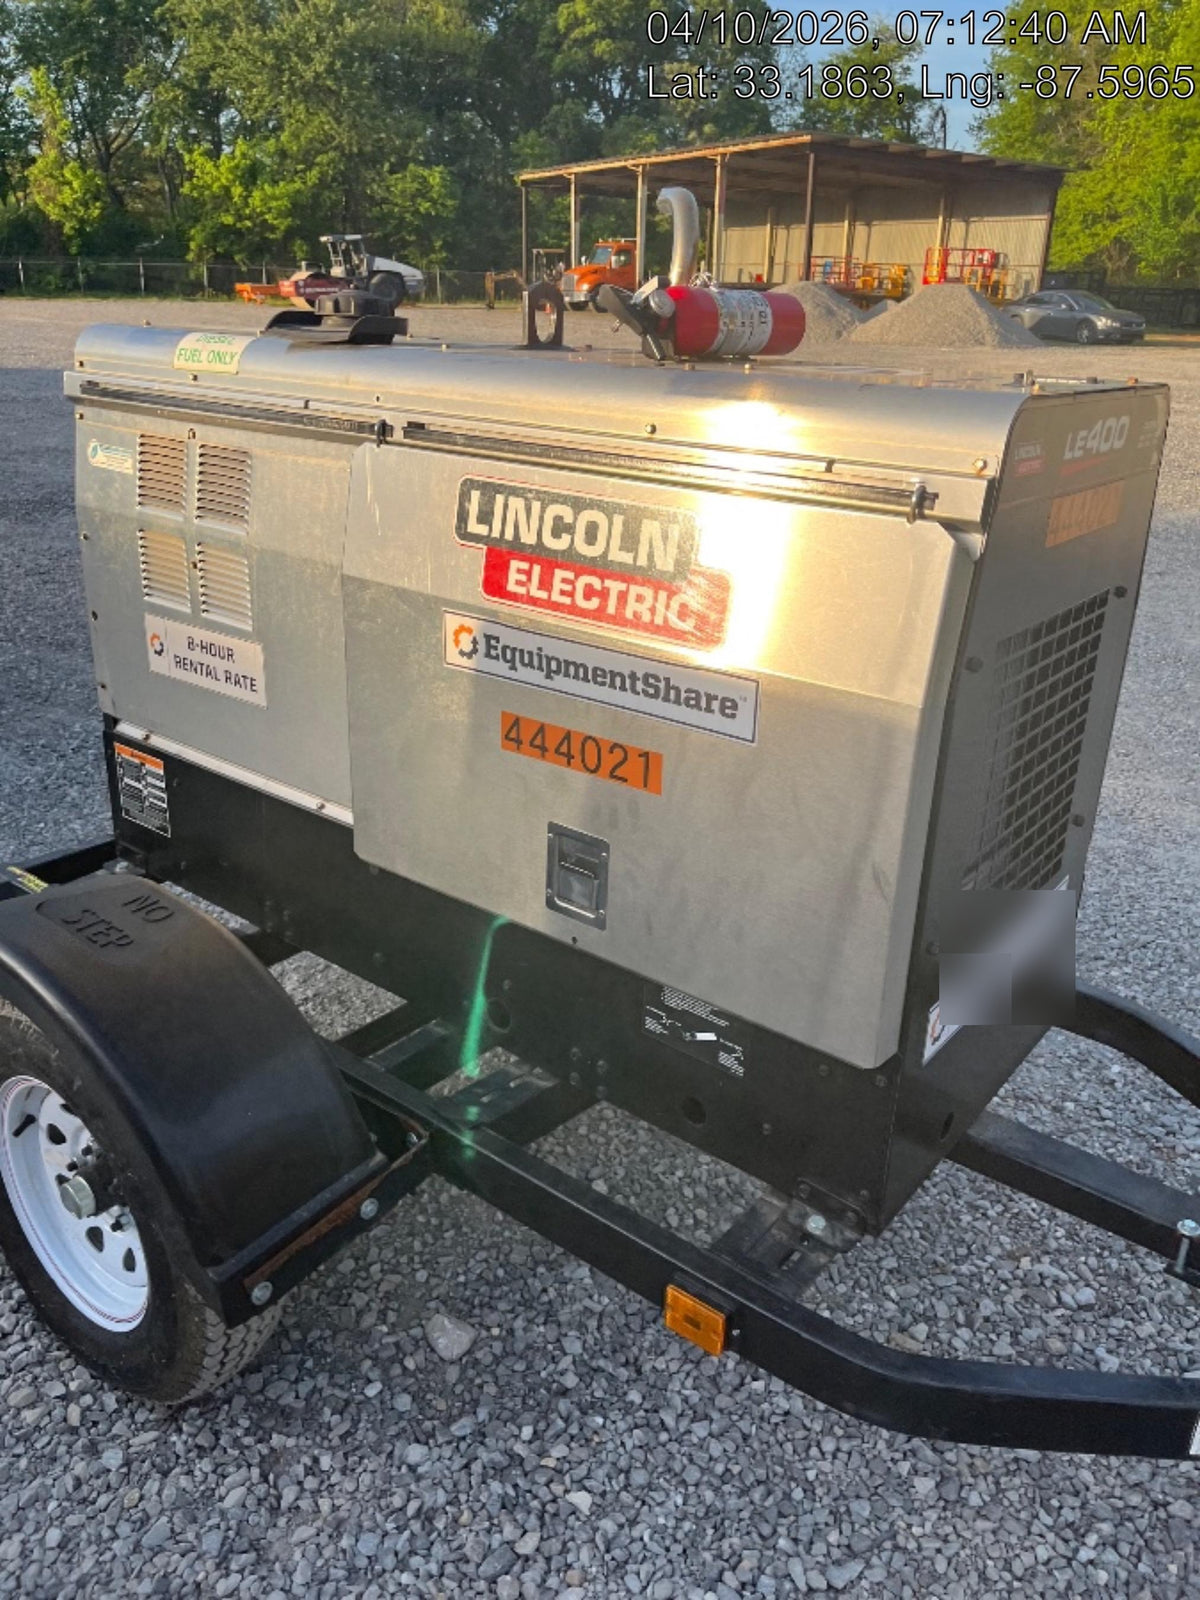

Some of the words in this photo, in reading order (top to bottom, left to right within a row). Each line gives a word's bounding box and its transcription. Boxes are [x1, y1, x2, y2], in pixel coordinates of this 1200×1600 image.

[177, 347, 203, 363] FUEL
[207, 349, 239, 365] ONLY
[1063, 415, 1130, 460] LE400
[466, 489, 680, 572] LINCOLN
[506, 559, 697, 632] ELECTRIC
[187, 636, 235, 663] 8-HOUR
[173, 654, 221, 682] RENTAL
[223, 669, 258, 693] RATE
[483, 632, 739, 720] EquipmentShare
[503, 717, 652, 788] 444021
[60, 908, 134, 948] STEP
[121, 895, 175, 923] NO
